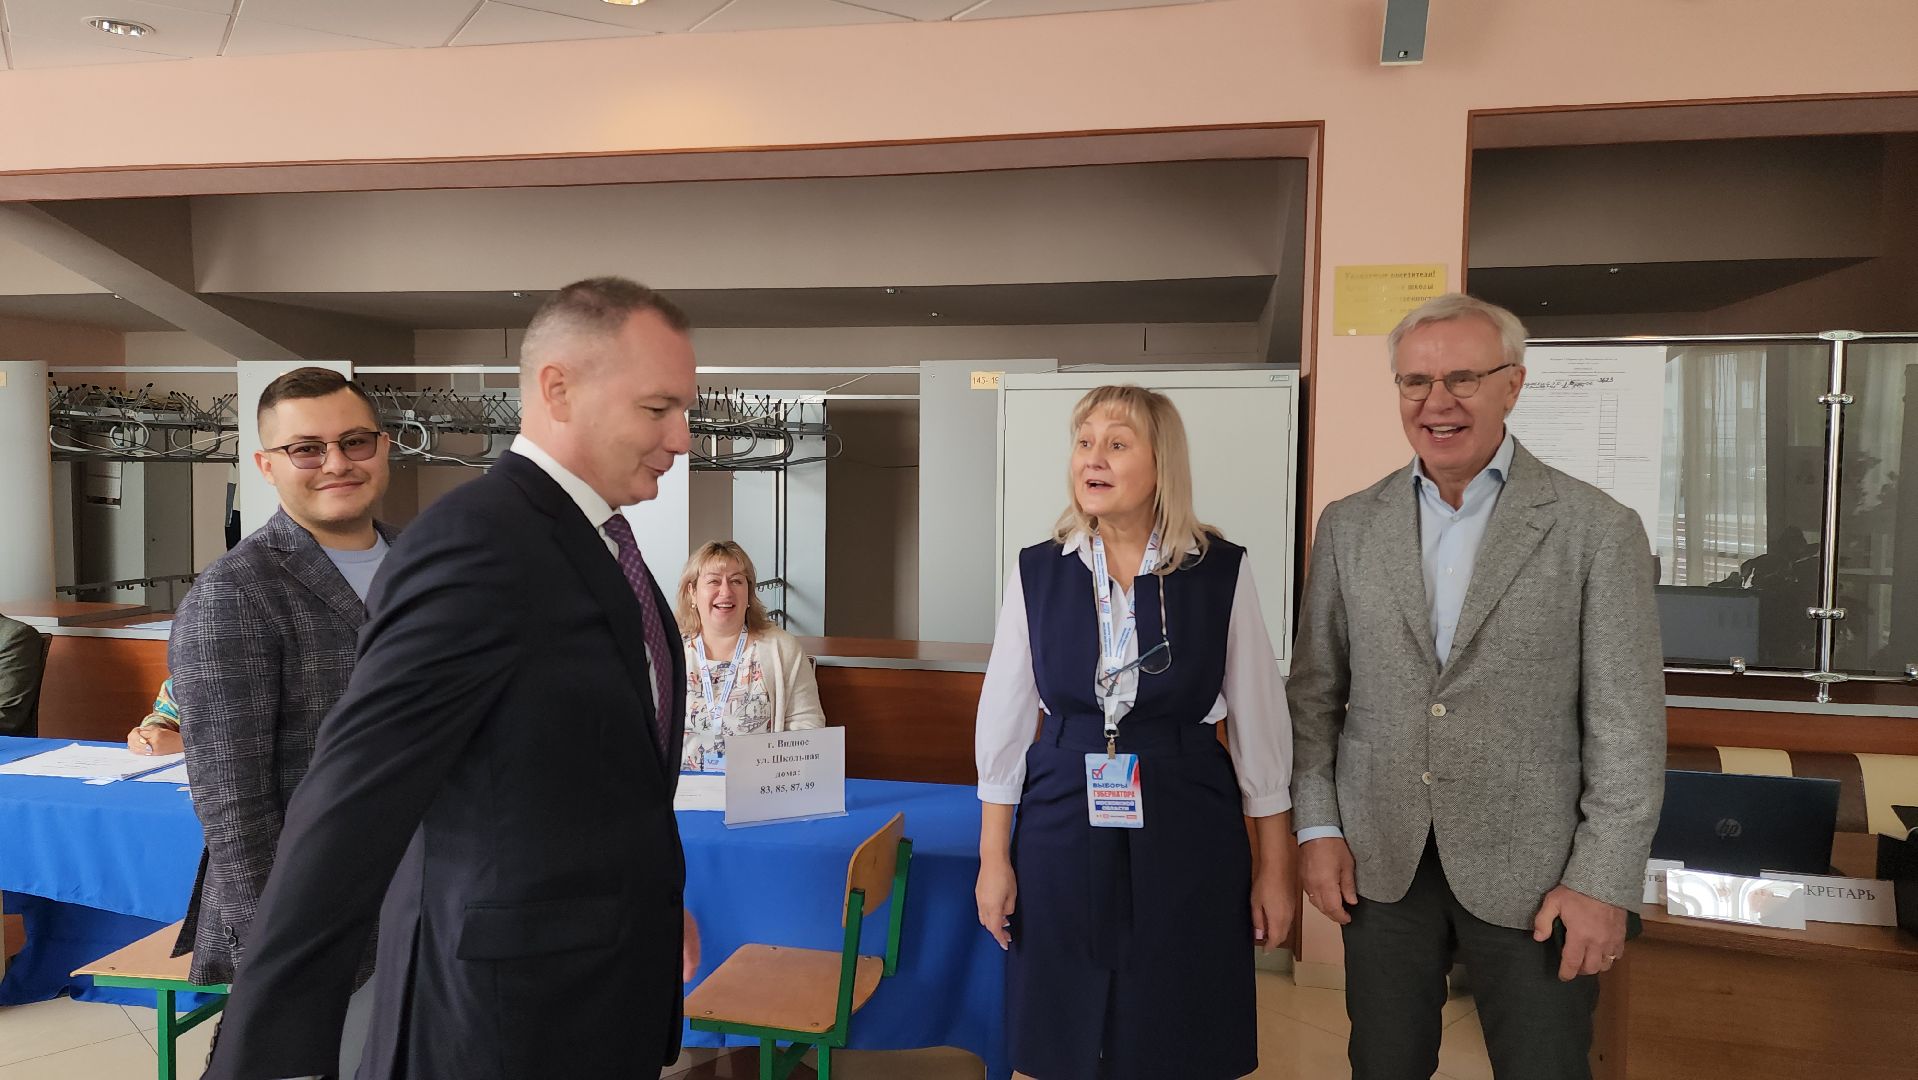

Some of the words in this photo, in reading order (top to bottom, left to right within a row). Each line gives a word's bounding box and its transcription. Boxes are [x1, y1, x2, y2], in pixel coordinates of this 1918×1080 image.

[777, 739, 810, 748] Видное
[756, 758, 770, 766] ул.
[772, 753, 820, 763] Школьная
[775, 770, 801, 778] дома:
[760, 785, 773, 794] 83,
[775, 784, 788, 793] 85,
[790, 782, 803, 791] 87,
[804, 781, 815, 789] 89
[1805, 884, 1876, 900] КРЕТАРЬ
